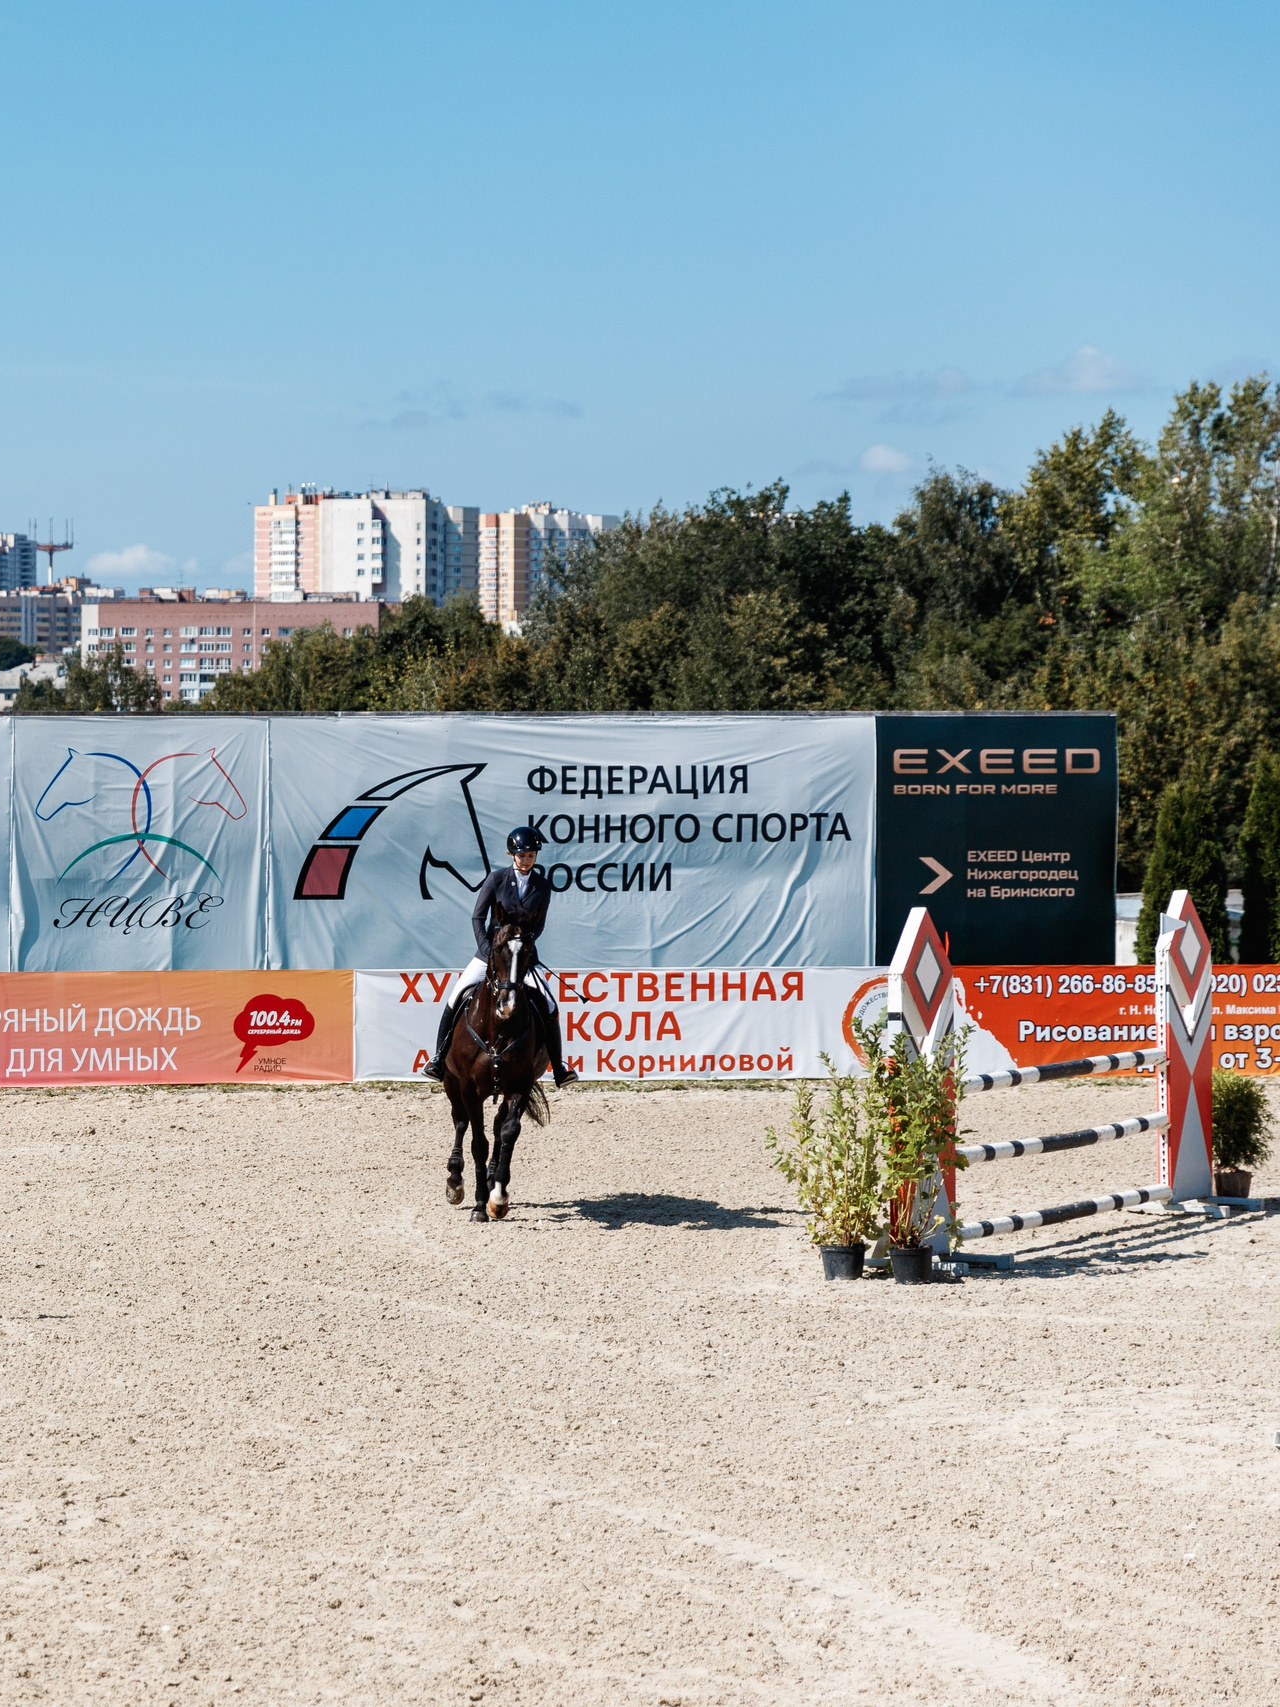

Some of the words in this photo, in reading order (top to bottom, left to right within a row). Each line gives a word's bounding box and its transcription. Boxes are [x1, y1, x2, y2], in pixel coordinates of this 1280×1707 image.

[893, 748, 1101, 774] EXEED
[527, 765, 748, 799] ФЕДЕРАЦИЯ
[893, 784, 951, 795] BORN
[955, 784, 996, 795] FOR
[1001, 784, 1058, 795] MORE
[527, 813, 701, 844] КОННОГО
[712, 812, 852, 842] СПОРТА
[967, 850, 1018, 862] EXEED
[1021, 850, 1071, 865] Центр
[966, 868, 1079, 881] Нижегородец
[966, 888, 987, 898] на
[989, 886, 1076, 899] Бринского
[399, 971, 805, 1003] ХУЕСТВЕННАЯ
[974, 974, 1054, 999] +7(831)
[93, 1006, 202, 1036] ДОЖДЬ
[1118, 1006, 1127, 1015] г.
[1129, 1005, 1142, 1015] Н.
[1225, 1004, 1276, 1015] Максима
[556, 1010, 682, 1042] КОЛА
[5, 1048, 63, 1077] ДЛЯ
[71, 1047, 178, 1073] УМНЫХ
[596, 1047, 794, 1078] Корниловой
[1219, 1051, 1249, 1070] от
